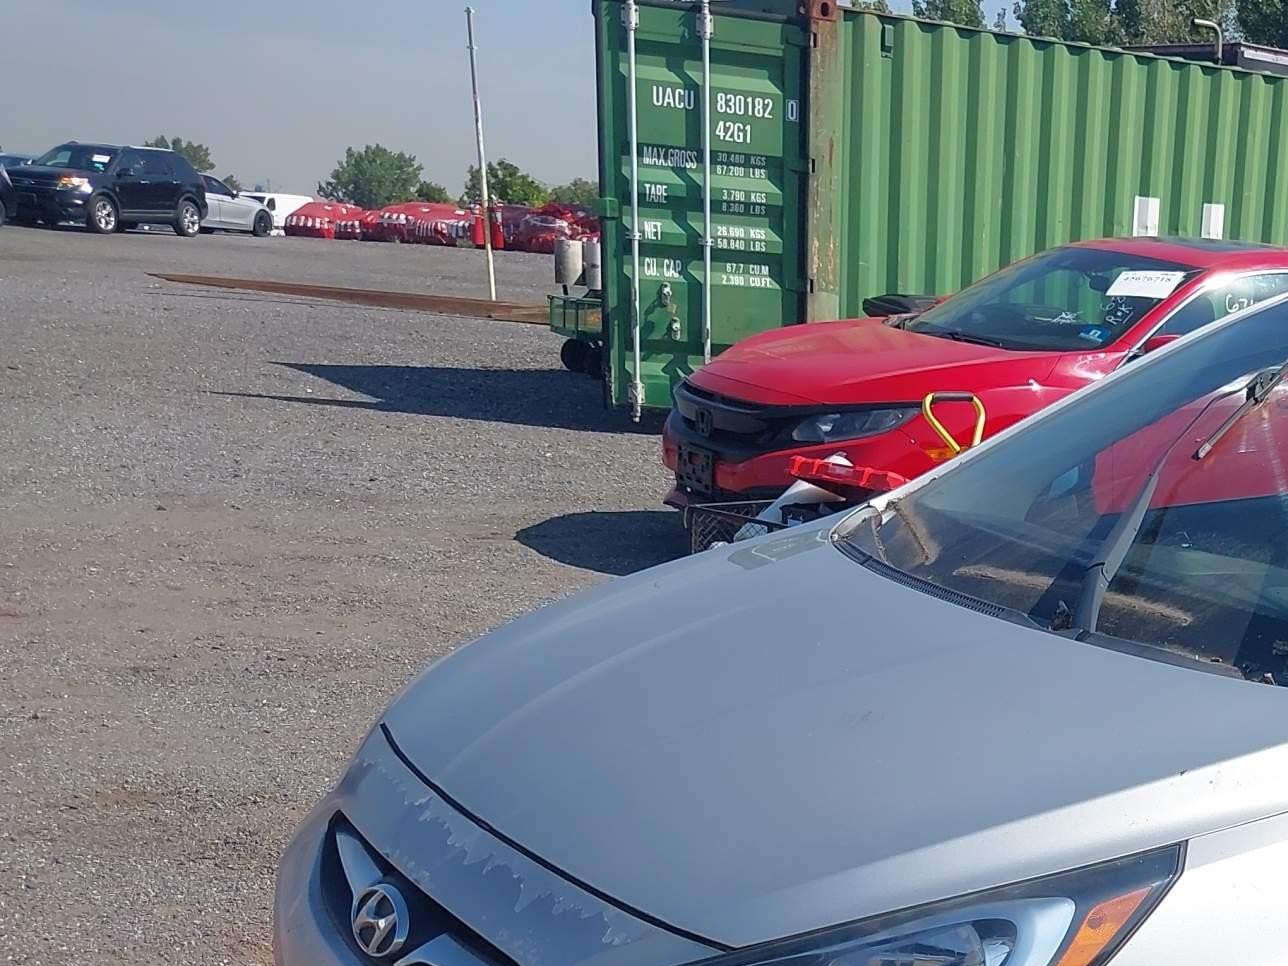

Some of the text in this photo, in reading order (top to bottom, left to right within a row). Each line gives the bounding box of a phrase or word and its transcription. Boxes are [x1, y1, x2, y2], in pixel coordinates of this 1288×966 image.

[652, 85, 694, 110] UACU
[716, 92, 773, 119] 830182
[715, 120, 751, 144] 42G1
[750, 154, 767, 166] KGS
[750, 167, 766, 179] LBS
[644, 183, 668, 204] TARE
[750, 192, 767, 203] KGS
[750, 204, 766, 215] LBS
[643, 221, 663, 241] NET
[750, 228, 766, 240] KGS
[750, 240, 766, 252] LBS
